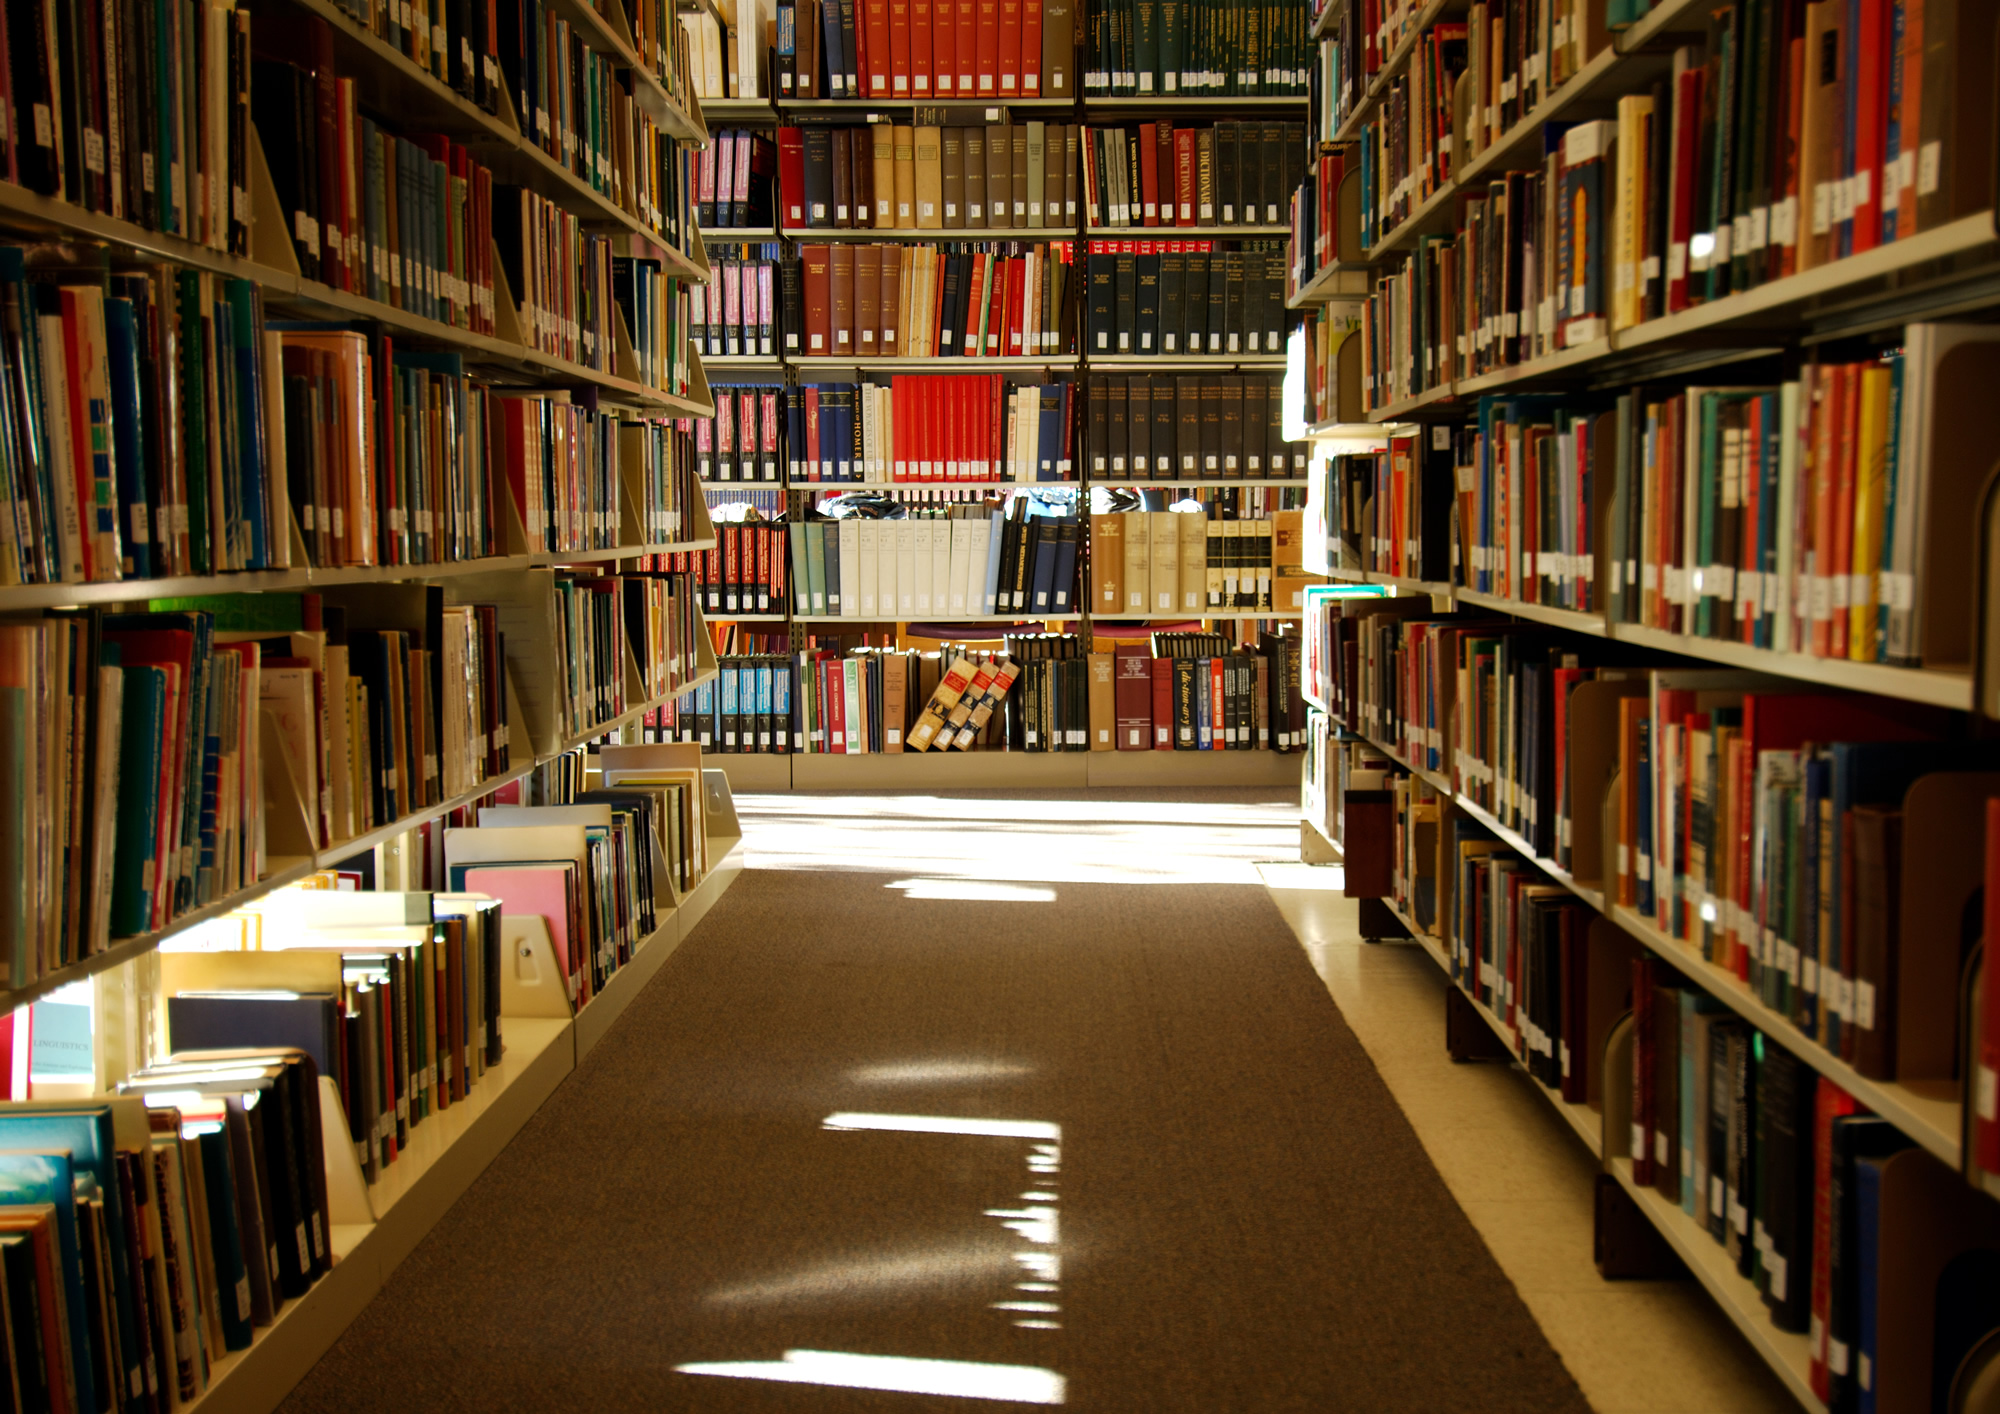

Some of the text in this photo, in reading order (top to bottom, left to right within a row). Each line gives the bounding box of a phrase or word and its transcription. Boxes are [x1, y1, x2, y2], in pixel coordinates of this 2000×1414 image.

[1180, 152, 1191, 203] DICTIONA
[1199, 151, 1211, 204] DICTIONAR
[864, 387, 873, 404] THE
[864, 404, 873, 438] VOYAGES
[853, 421, 862, 459] HOMER
[866, 438, 873, 449] OF
[1214, 674, 1222, 689] WORD
[1214, 688, 1222, 714] FREQUENCY
[33, 1039, 89, 1051] LINGUISTICS
